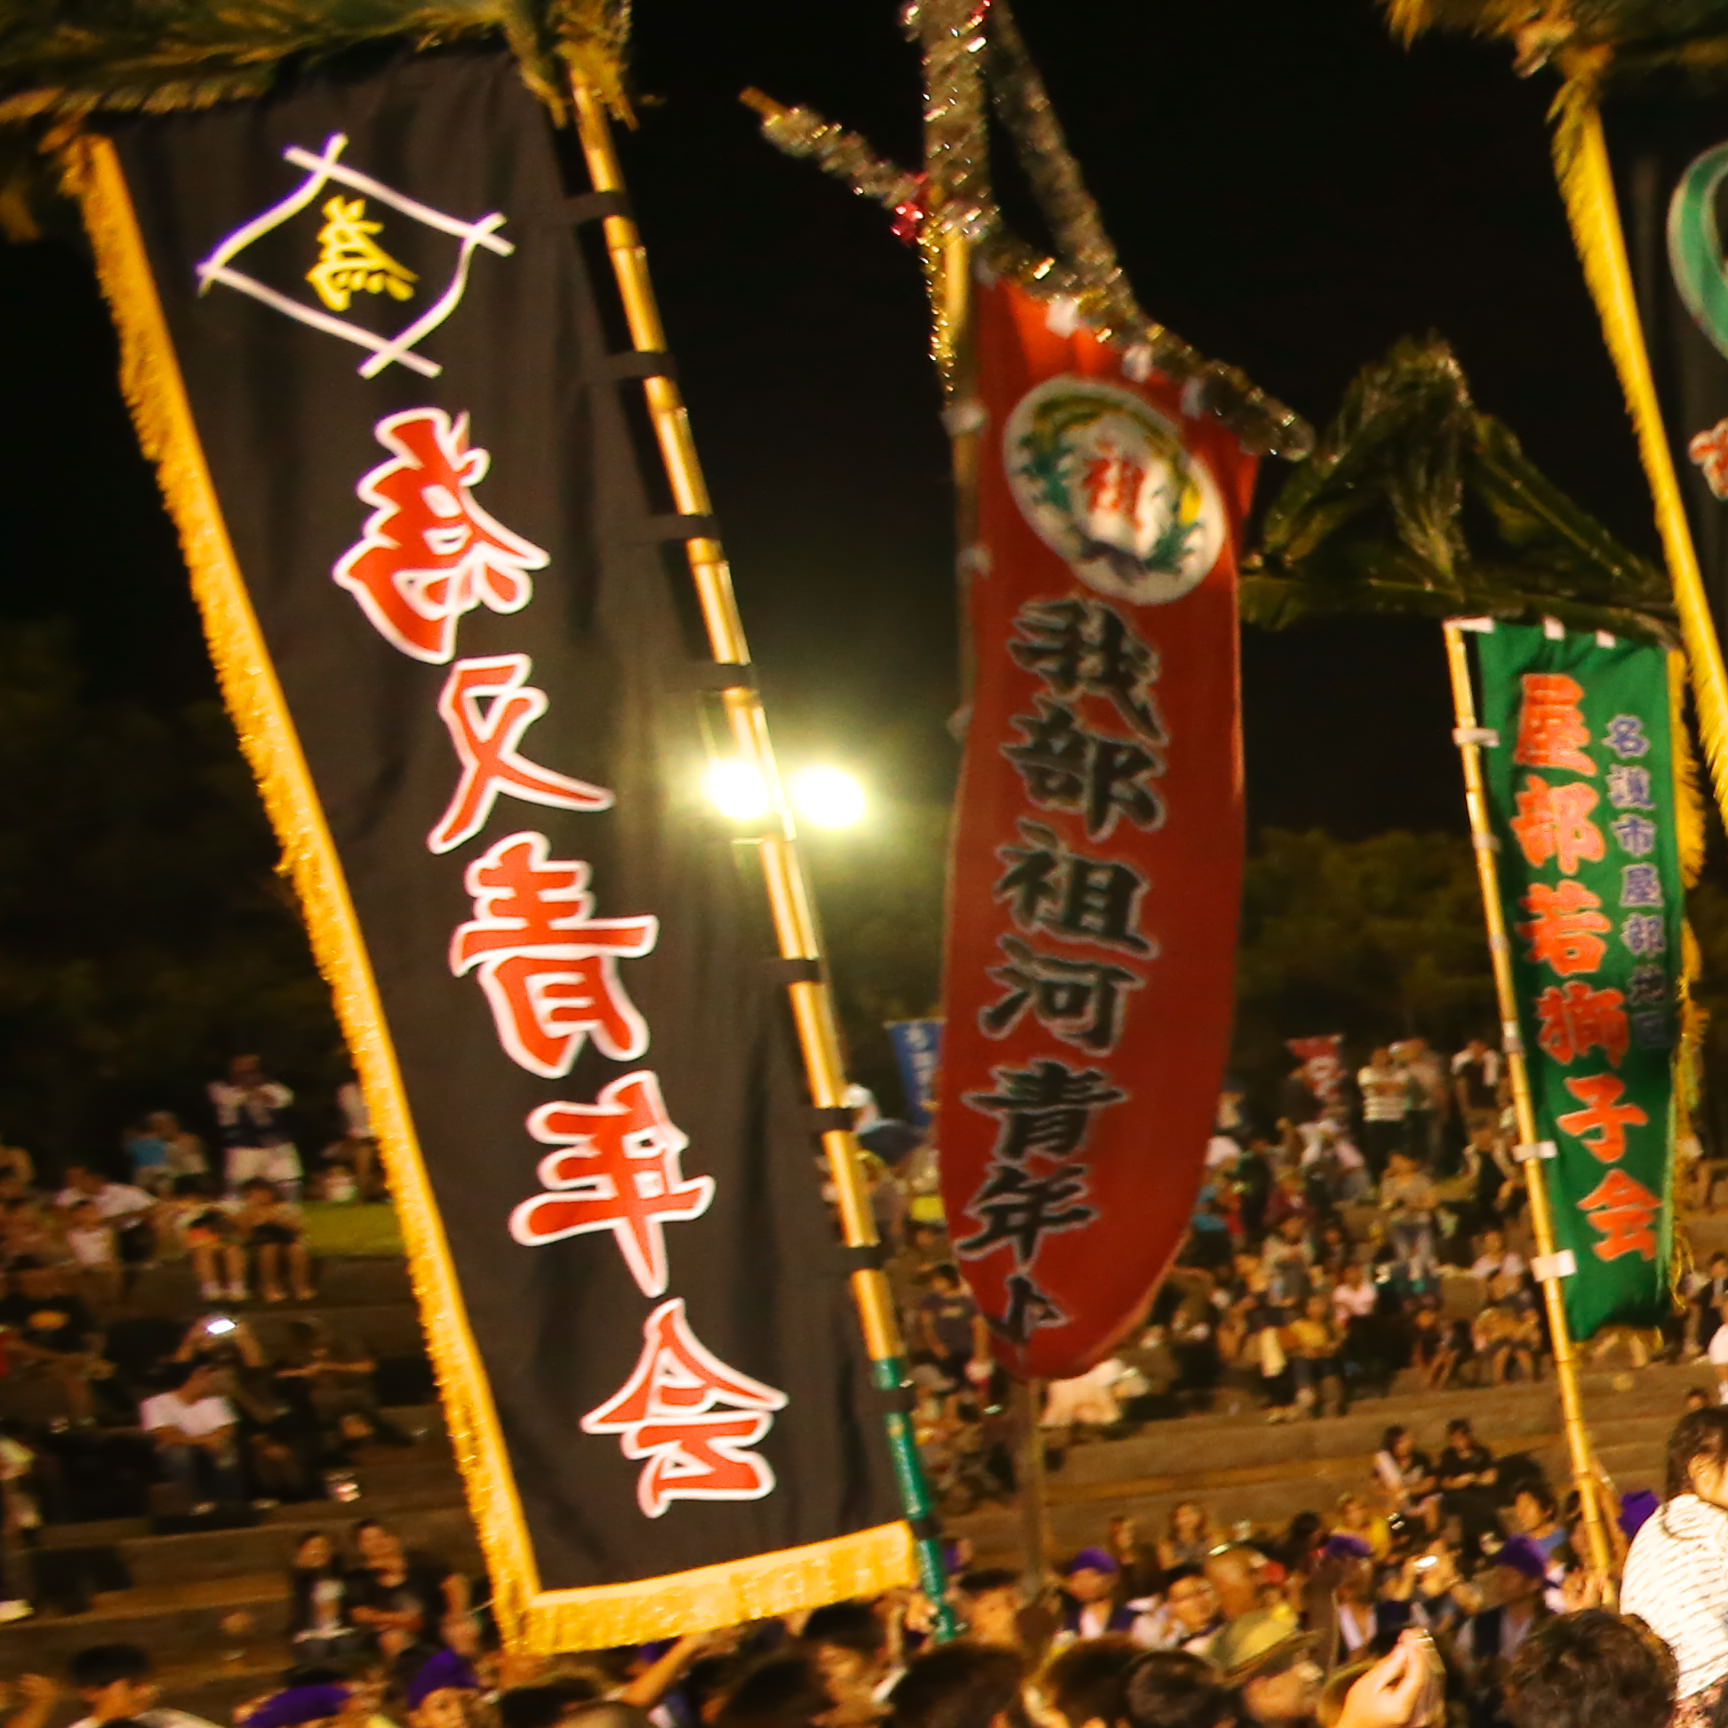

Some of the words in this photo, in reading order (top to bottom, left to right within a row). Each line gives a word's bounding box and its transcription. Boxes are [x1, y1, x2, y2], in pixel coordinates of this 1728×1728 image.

[333, 406, 788, 1518] 為又青年会
